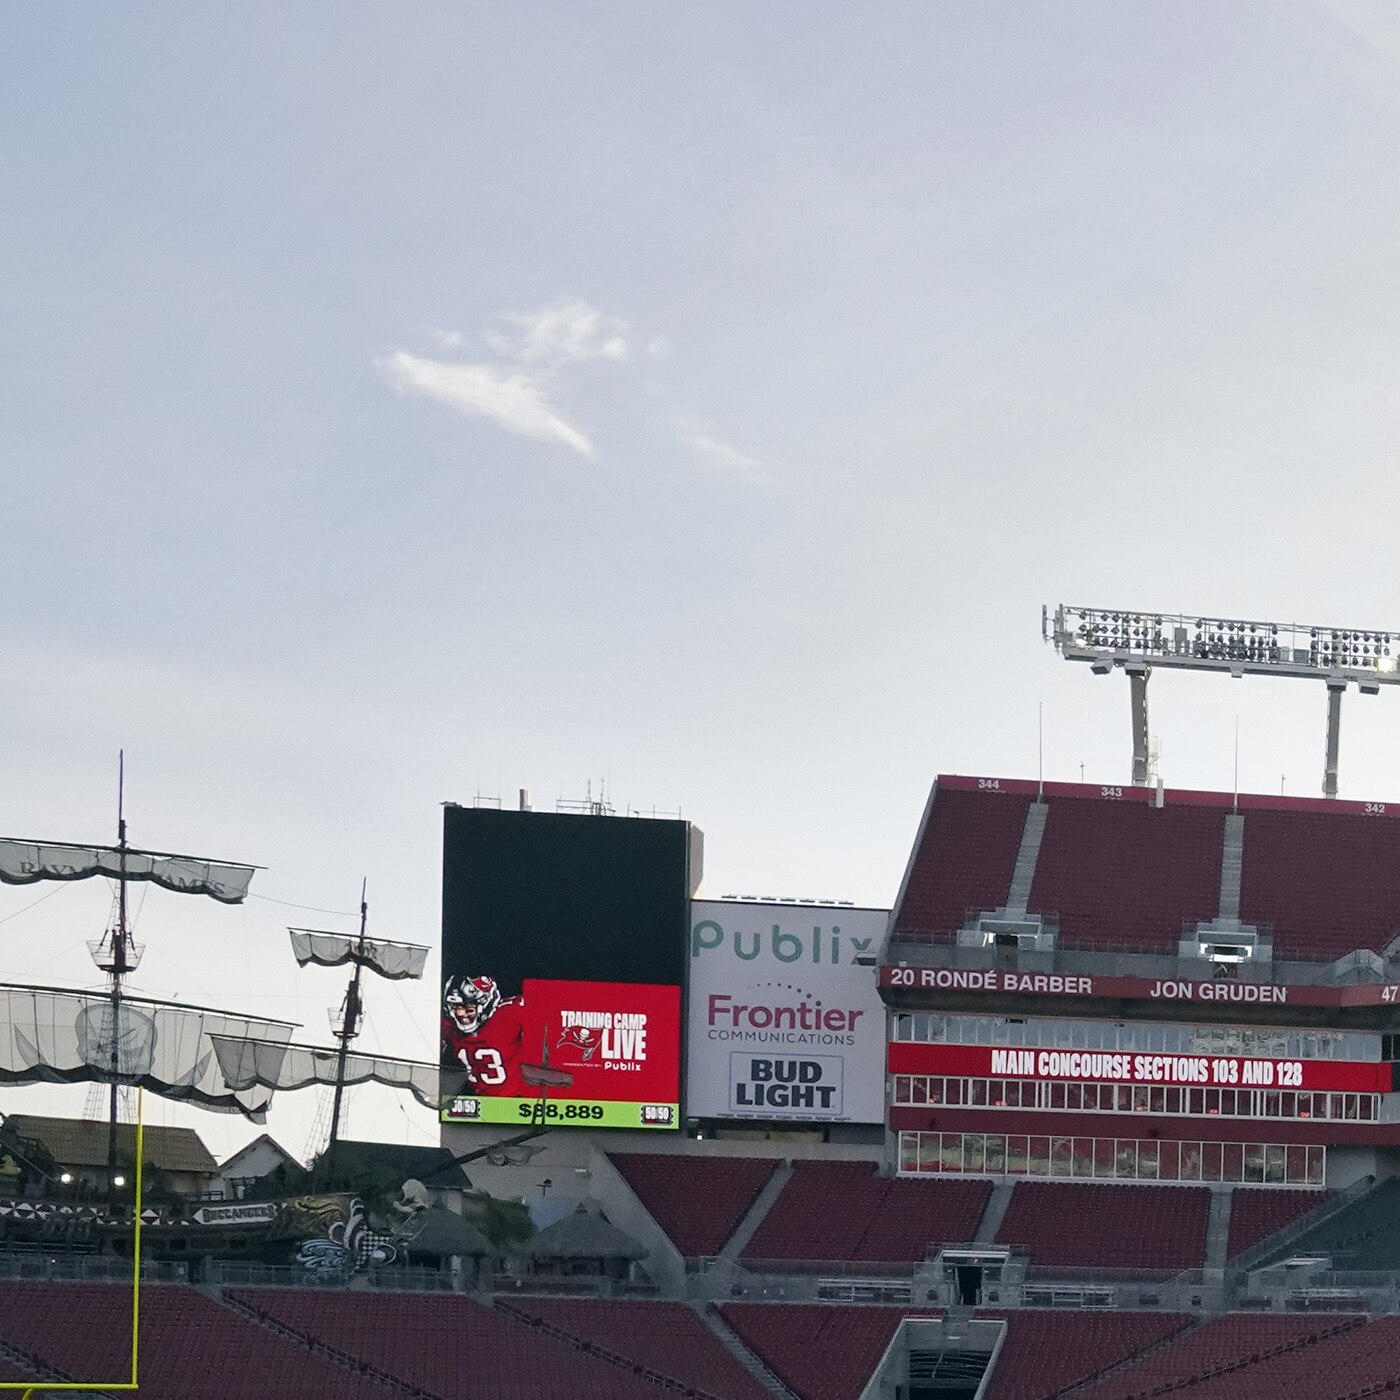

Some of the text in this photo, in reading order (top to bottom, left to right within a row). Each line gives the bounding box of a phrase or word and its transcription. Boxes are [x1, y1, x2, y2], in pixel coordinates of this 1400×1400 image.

[978, 779, 1000, 790] 344
[1100, 786, 1123, 797] 343
[1364, 803, 1386, 814] 342
[692, 918, 873, 965] Publix
[890, 969, 1093, 994] 20 RONDÉ BARBER
[1150, 980, 1287, 1003] JON GRUDEN
[1382, 986, 1398, 1003] 47
[560, 1010, 648, 1030] TRAINING CAMP
[708, 994, 864, 1032] Frontier
[601, 1028, 647, 1061] LIVE
[708, 1029, 856, 1046] COMMUNICATIONS
[604, 1061, 642, 1072] Publix
[751, 1059, 823, 1084] BUD
[991, 1049, 1303, 1086] MAIN CONCOURSE SECTIONS 103 AND 128
[736, 1083, 836, 1109] LIGHT
[518, 1103, 605, 1120] $88,889
